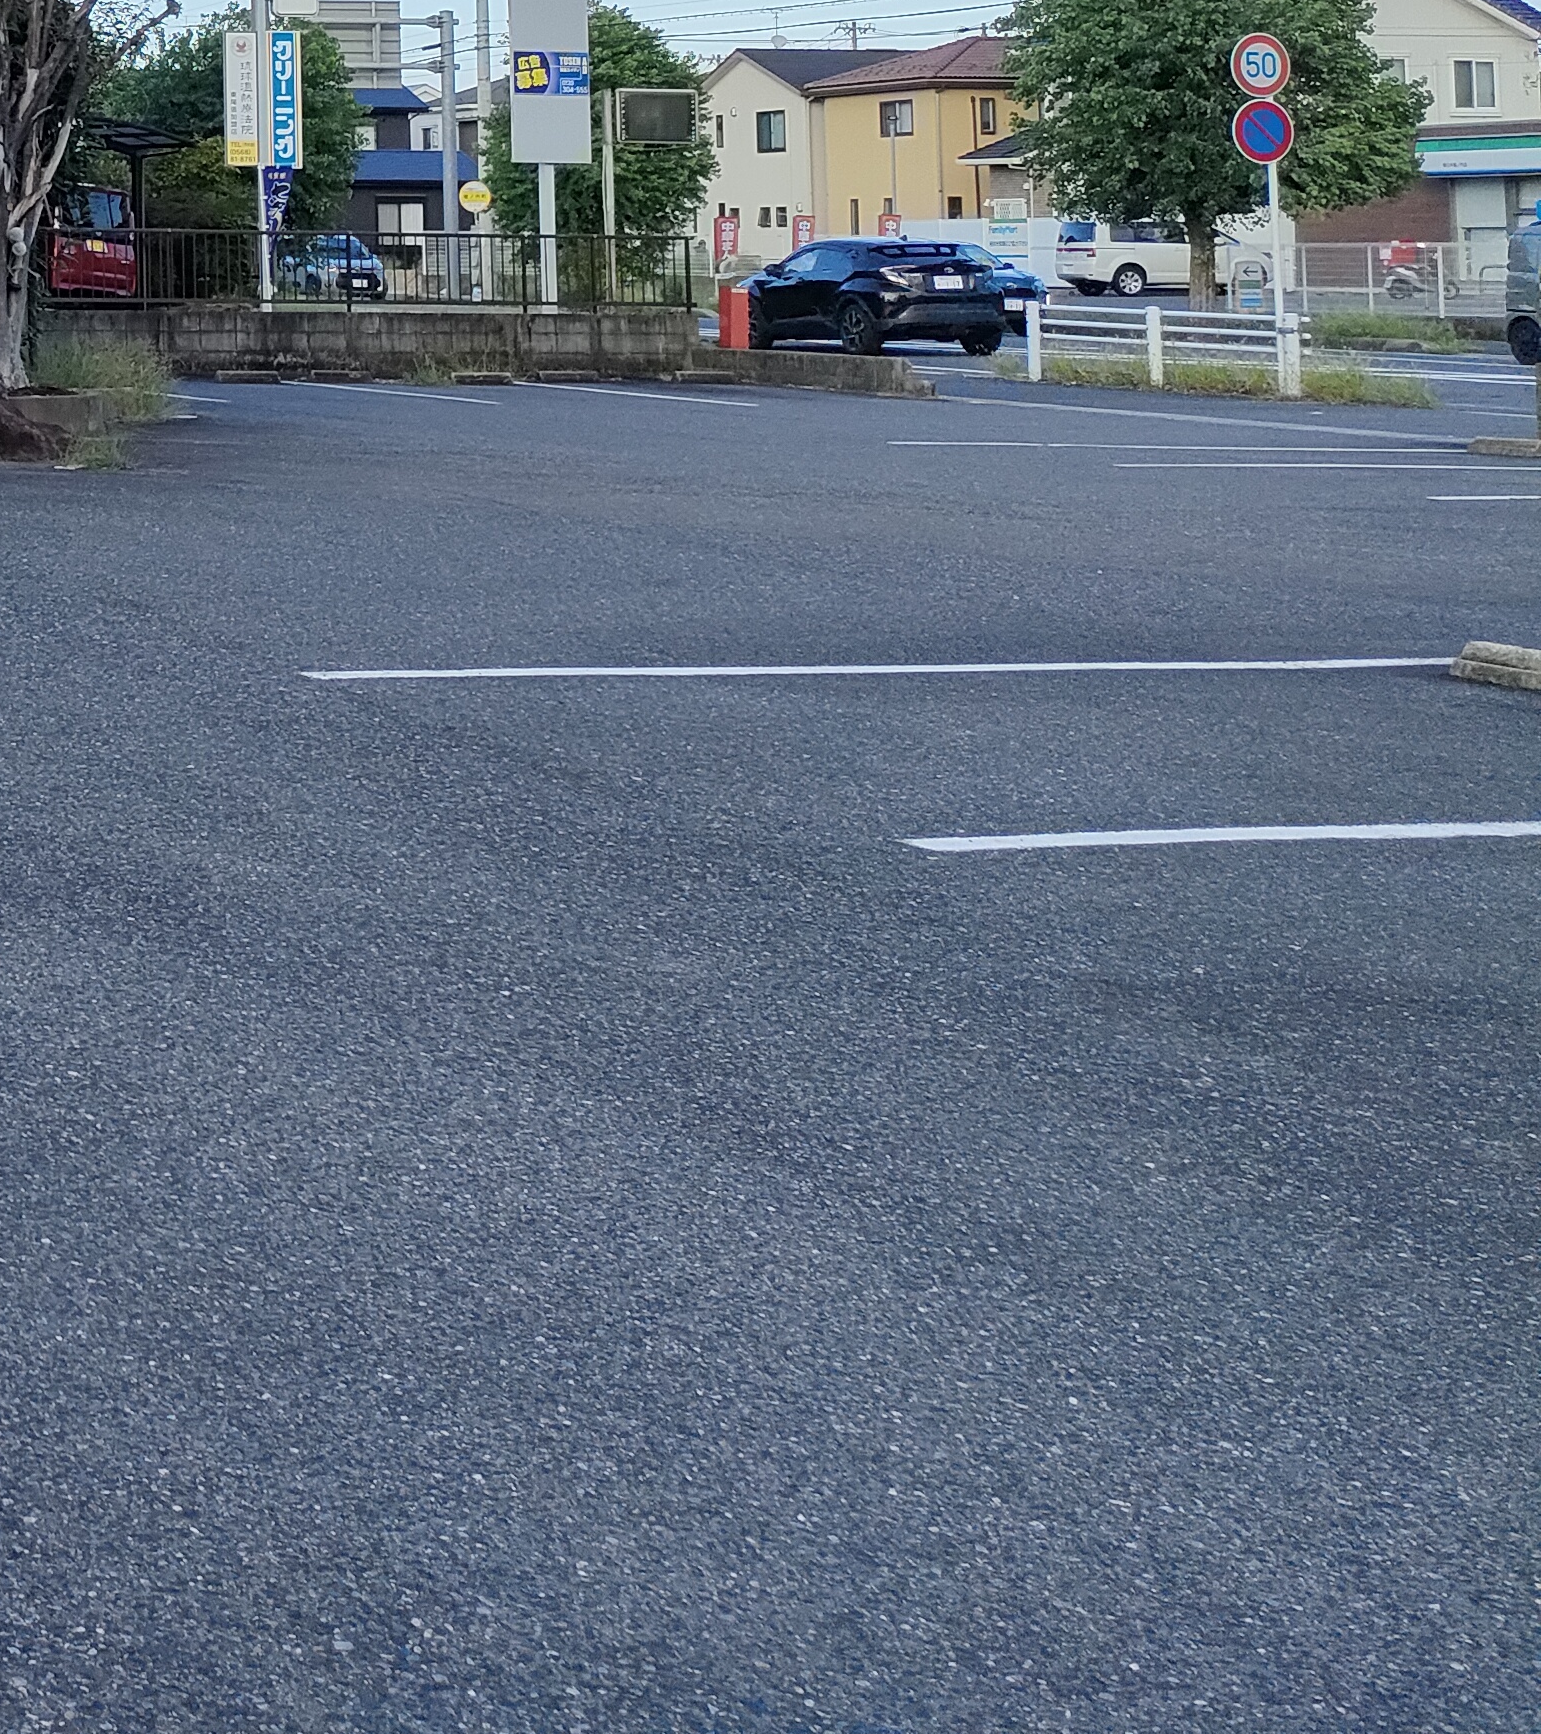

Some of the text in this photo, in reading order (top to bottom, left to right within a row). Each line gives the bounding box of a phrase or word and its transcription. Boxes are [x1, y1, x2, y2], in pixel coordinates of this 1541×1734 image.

[273, 40, 294, 159] クリーニング
[1245, 51, 1277, 79] 50
